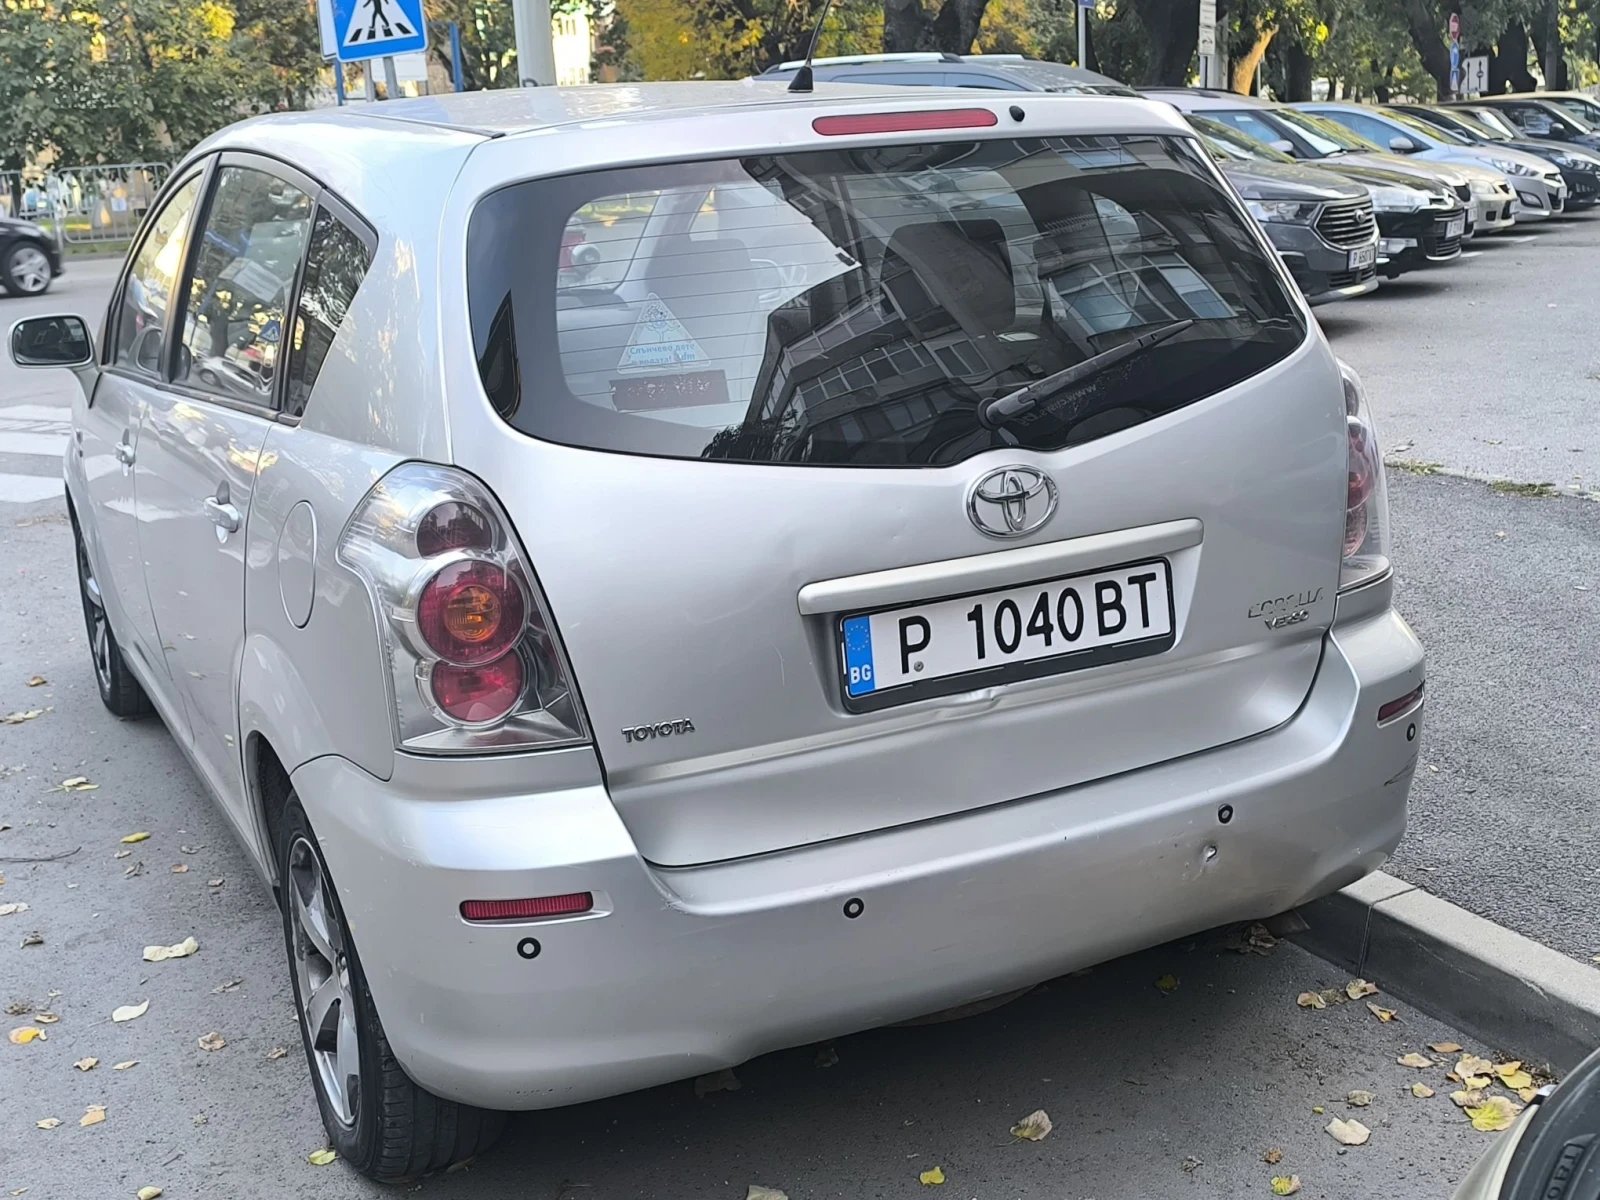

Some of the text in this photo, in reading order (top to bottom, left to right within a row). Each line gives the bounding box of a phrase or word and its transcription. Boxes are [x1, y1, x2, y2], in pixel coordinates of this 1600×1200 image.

[629, 343, 695, 355] Слънчево дете
[898, 572, 1157, 674] P 1040 BT
[850, 663, 872, 685] BG
[621, 717, 695, 743] TOYOTA
